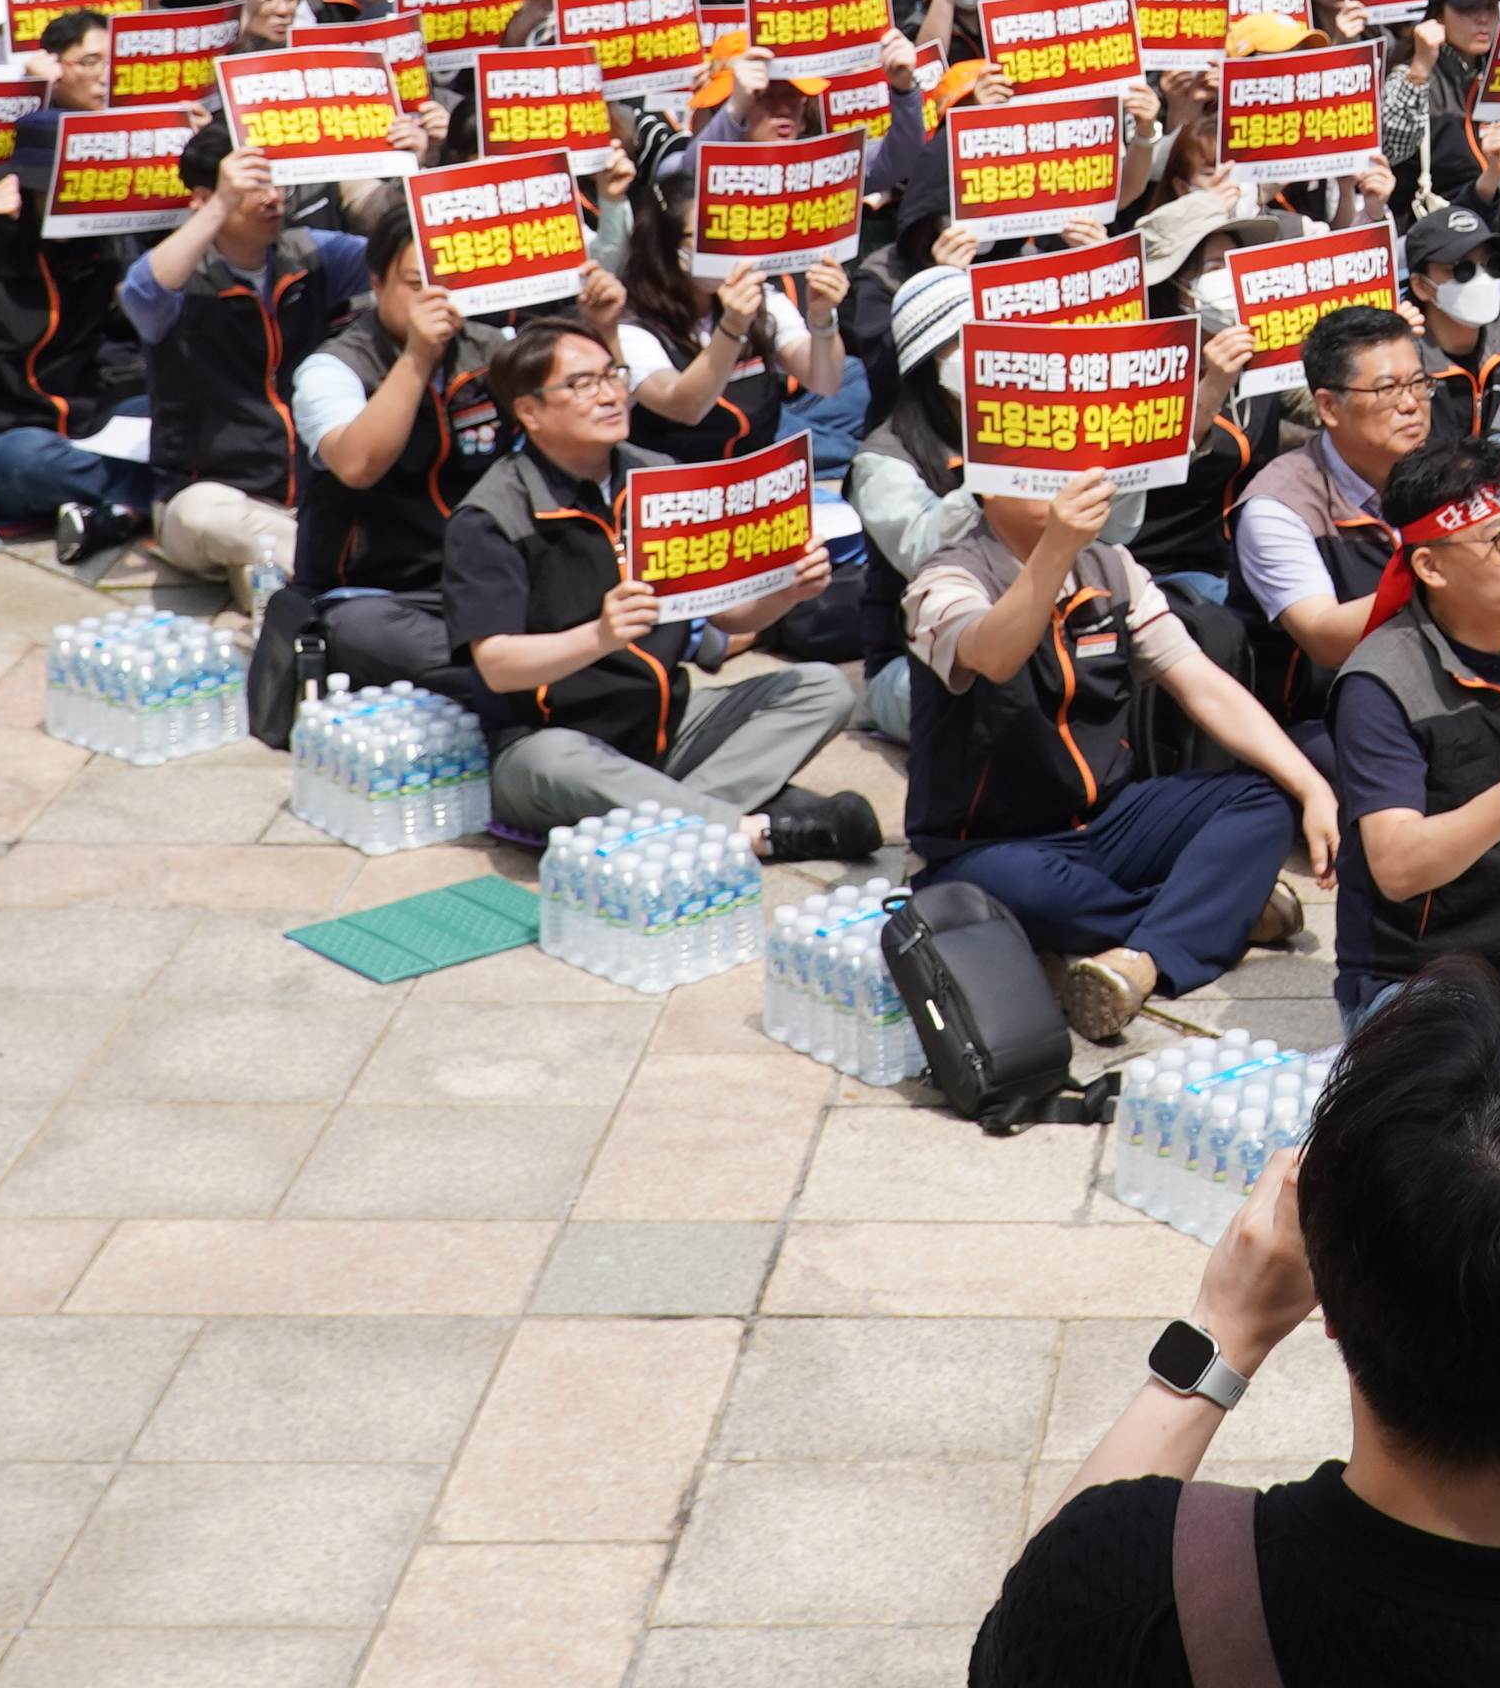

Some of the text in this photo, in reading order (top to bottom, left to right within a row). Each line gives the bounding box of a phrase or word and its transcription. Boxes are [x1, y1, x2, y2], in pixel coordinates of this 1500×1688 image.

[1230, 75, 1293, 108] 대주주만을
[1295, 74, 1321, 101] 위한
[960, 125, 1031, 158] 대주주만을
[1033, 123, 1060, 149] 위한
[1228, 102, 1374, 150] 고용보장 약속하라!
[961, 155, 1113, 203] 고용보장 약속하라!
[975, 349, 1067, 393] 대주주만을
[1071, 350, 1117, 390] 위한
[976, 398, 1184, 450] 고용보장 약속하라!
[640, 487, 725, 529] 대주주만을
[727, 481, 757, 518] 위한
[642, 507, 811, 582] 고용보장 약속하라!
